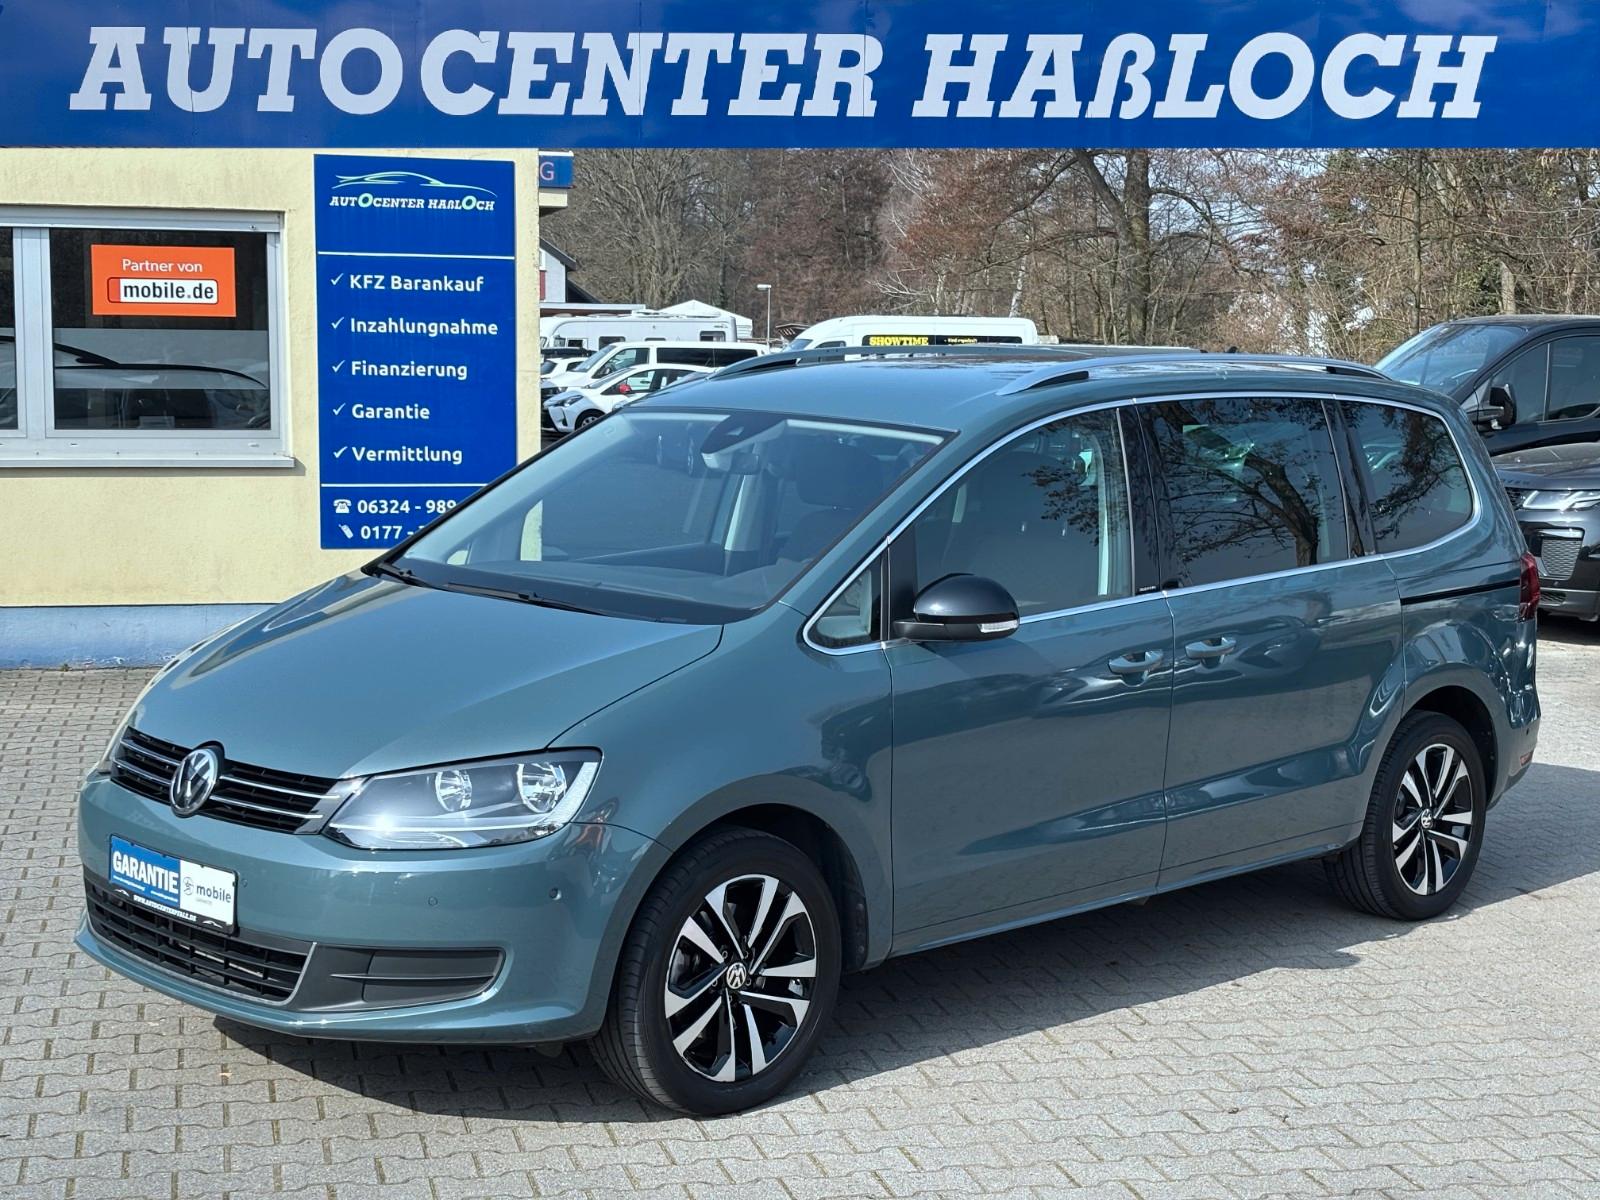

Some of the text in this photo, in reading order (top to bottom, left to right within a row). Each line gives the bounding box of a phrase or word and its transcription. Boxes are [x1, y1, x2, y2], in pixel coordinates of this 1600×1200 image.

[69, 26, 1498, 119] AUTOCENTER HAßLOCH
[329, 193, 425, 209] AUTOCENTER
[122, 259, 203, 272] Partner von
[123, 282, 214, 299] mobile.de
[350, 275, 484, 292] KFZ Barankauf
[350, 318, 498, 337] Inzahlungnahme
[351, 361, 468, 380] Finanzierung
[352, 404, 430, 419] Garantie
[352, 446, 463, 464] Vermittlung
[357, 500, 410, 513] 06324
[360, 526, 402, 540] 0177
[112, 851, 179, 894] GARANTIE
[196, 884, 232, 903] mobile
